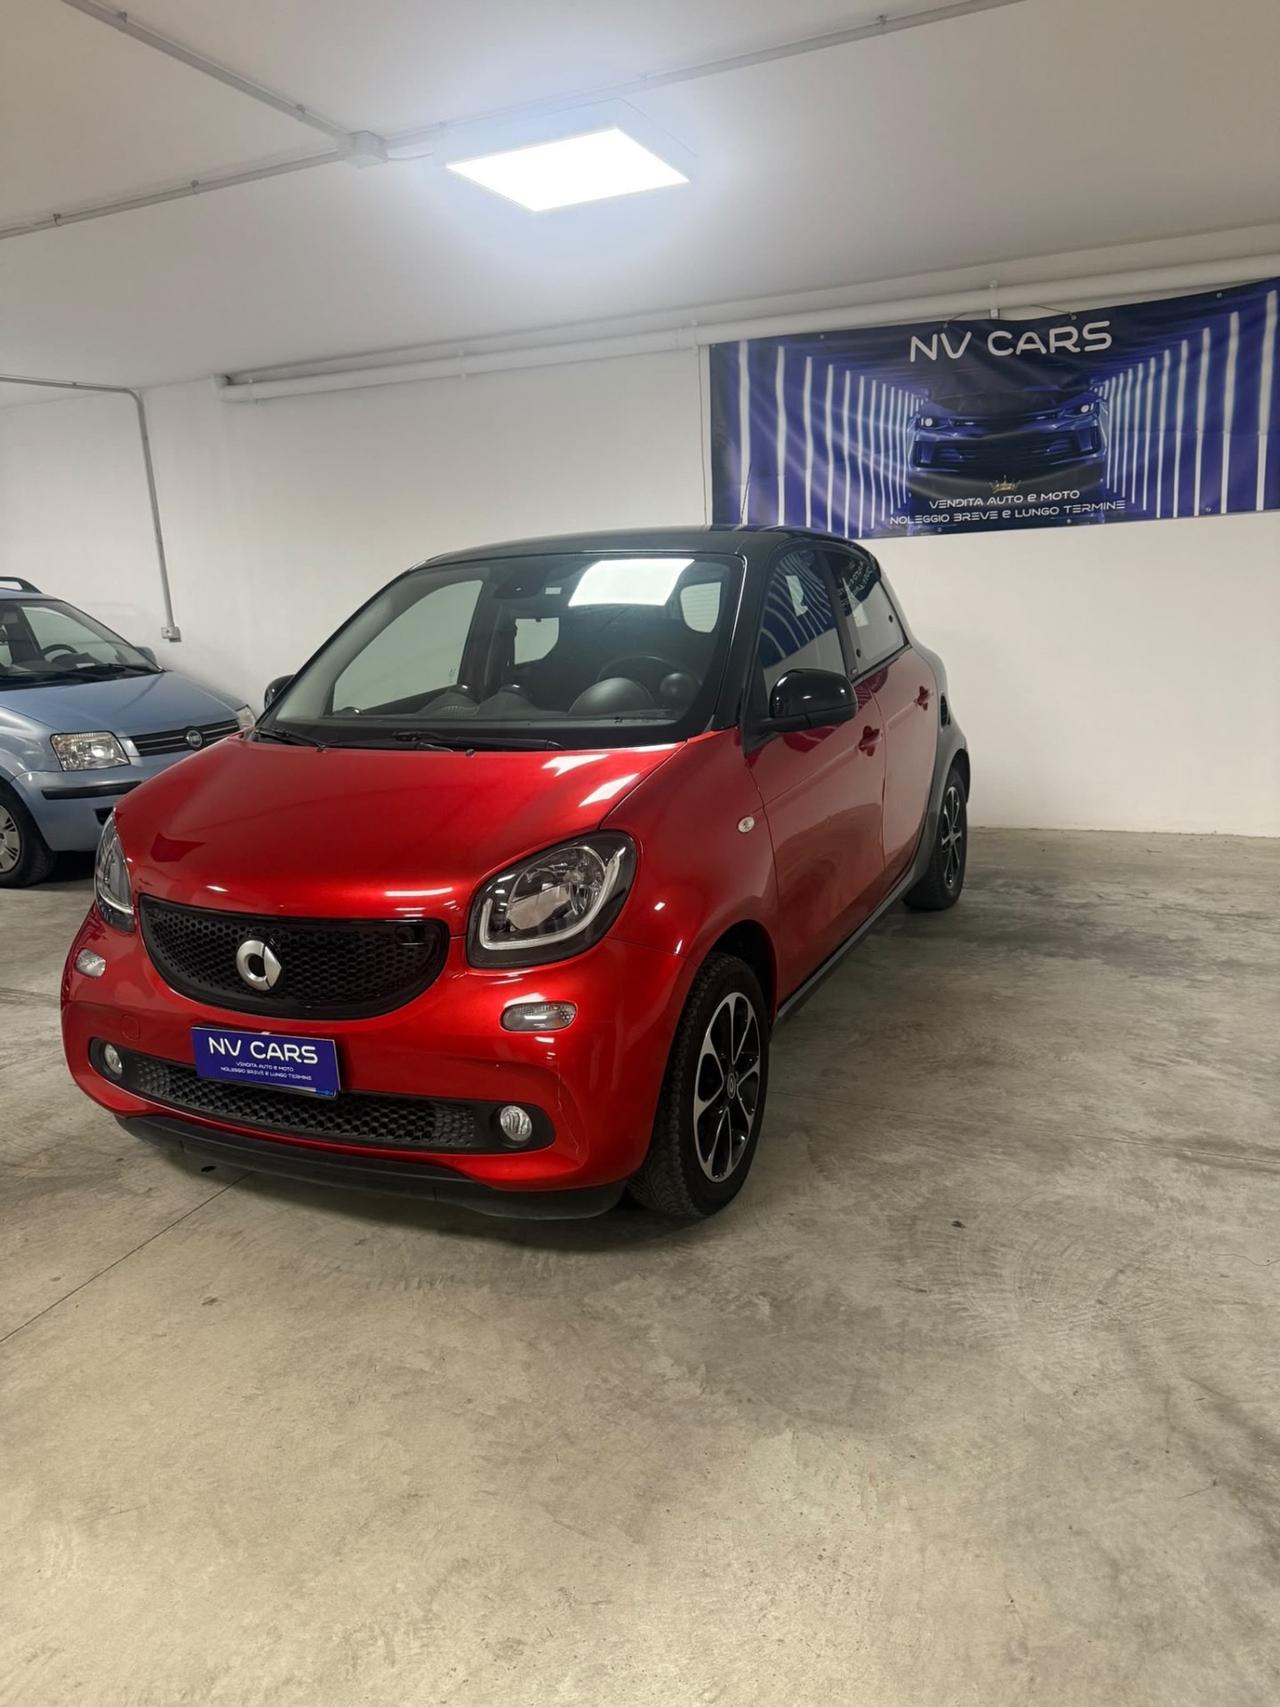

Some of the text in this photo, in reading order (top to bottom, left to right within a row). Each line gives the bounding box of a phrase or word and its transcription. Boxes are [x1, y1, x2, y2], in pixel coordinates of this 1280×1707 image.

[909, 320, 1113, 363] NV CARS
[889, 513, 950, 526] NOLEGGIO
[953, 510, 999, 523] BREVE
[1015, 506, 1060, 518] LUNGO
[1063, 500, 1127, 514] TERMINE
[929, 496, 984, 510] VENDITA
[986, 494, 1024, 506] AUTO
[1040, 489, 1081, 501] MOTO
[208, 1036, 318, 1065] NV CARS
